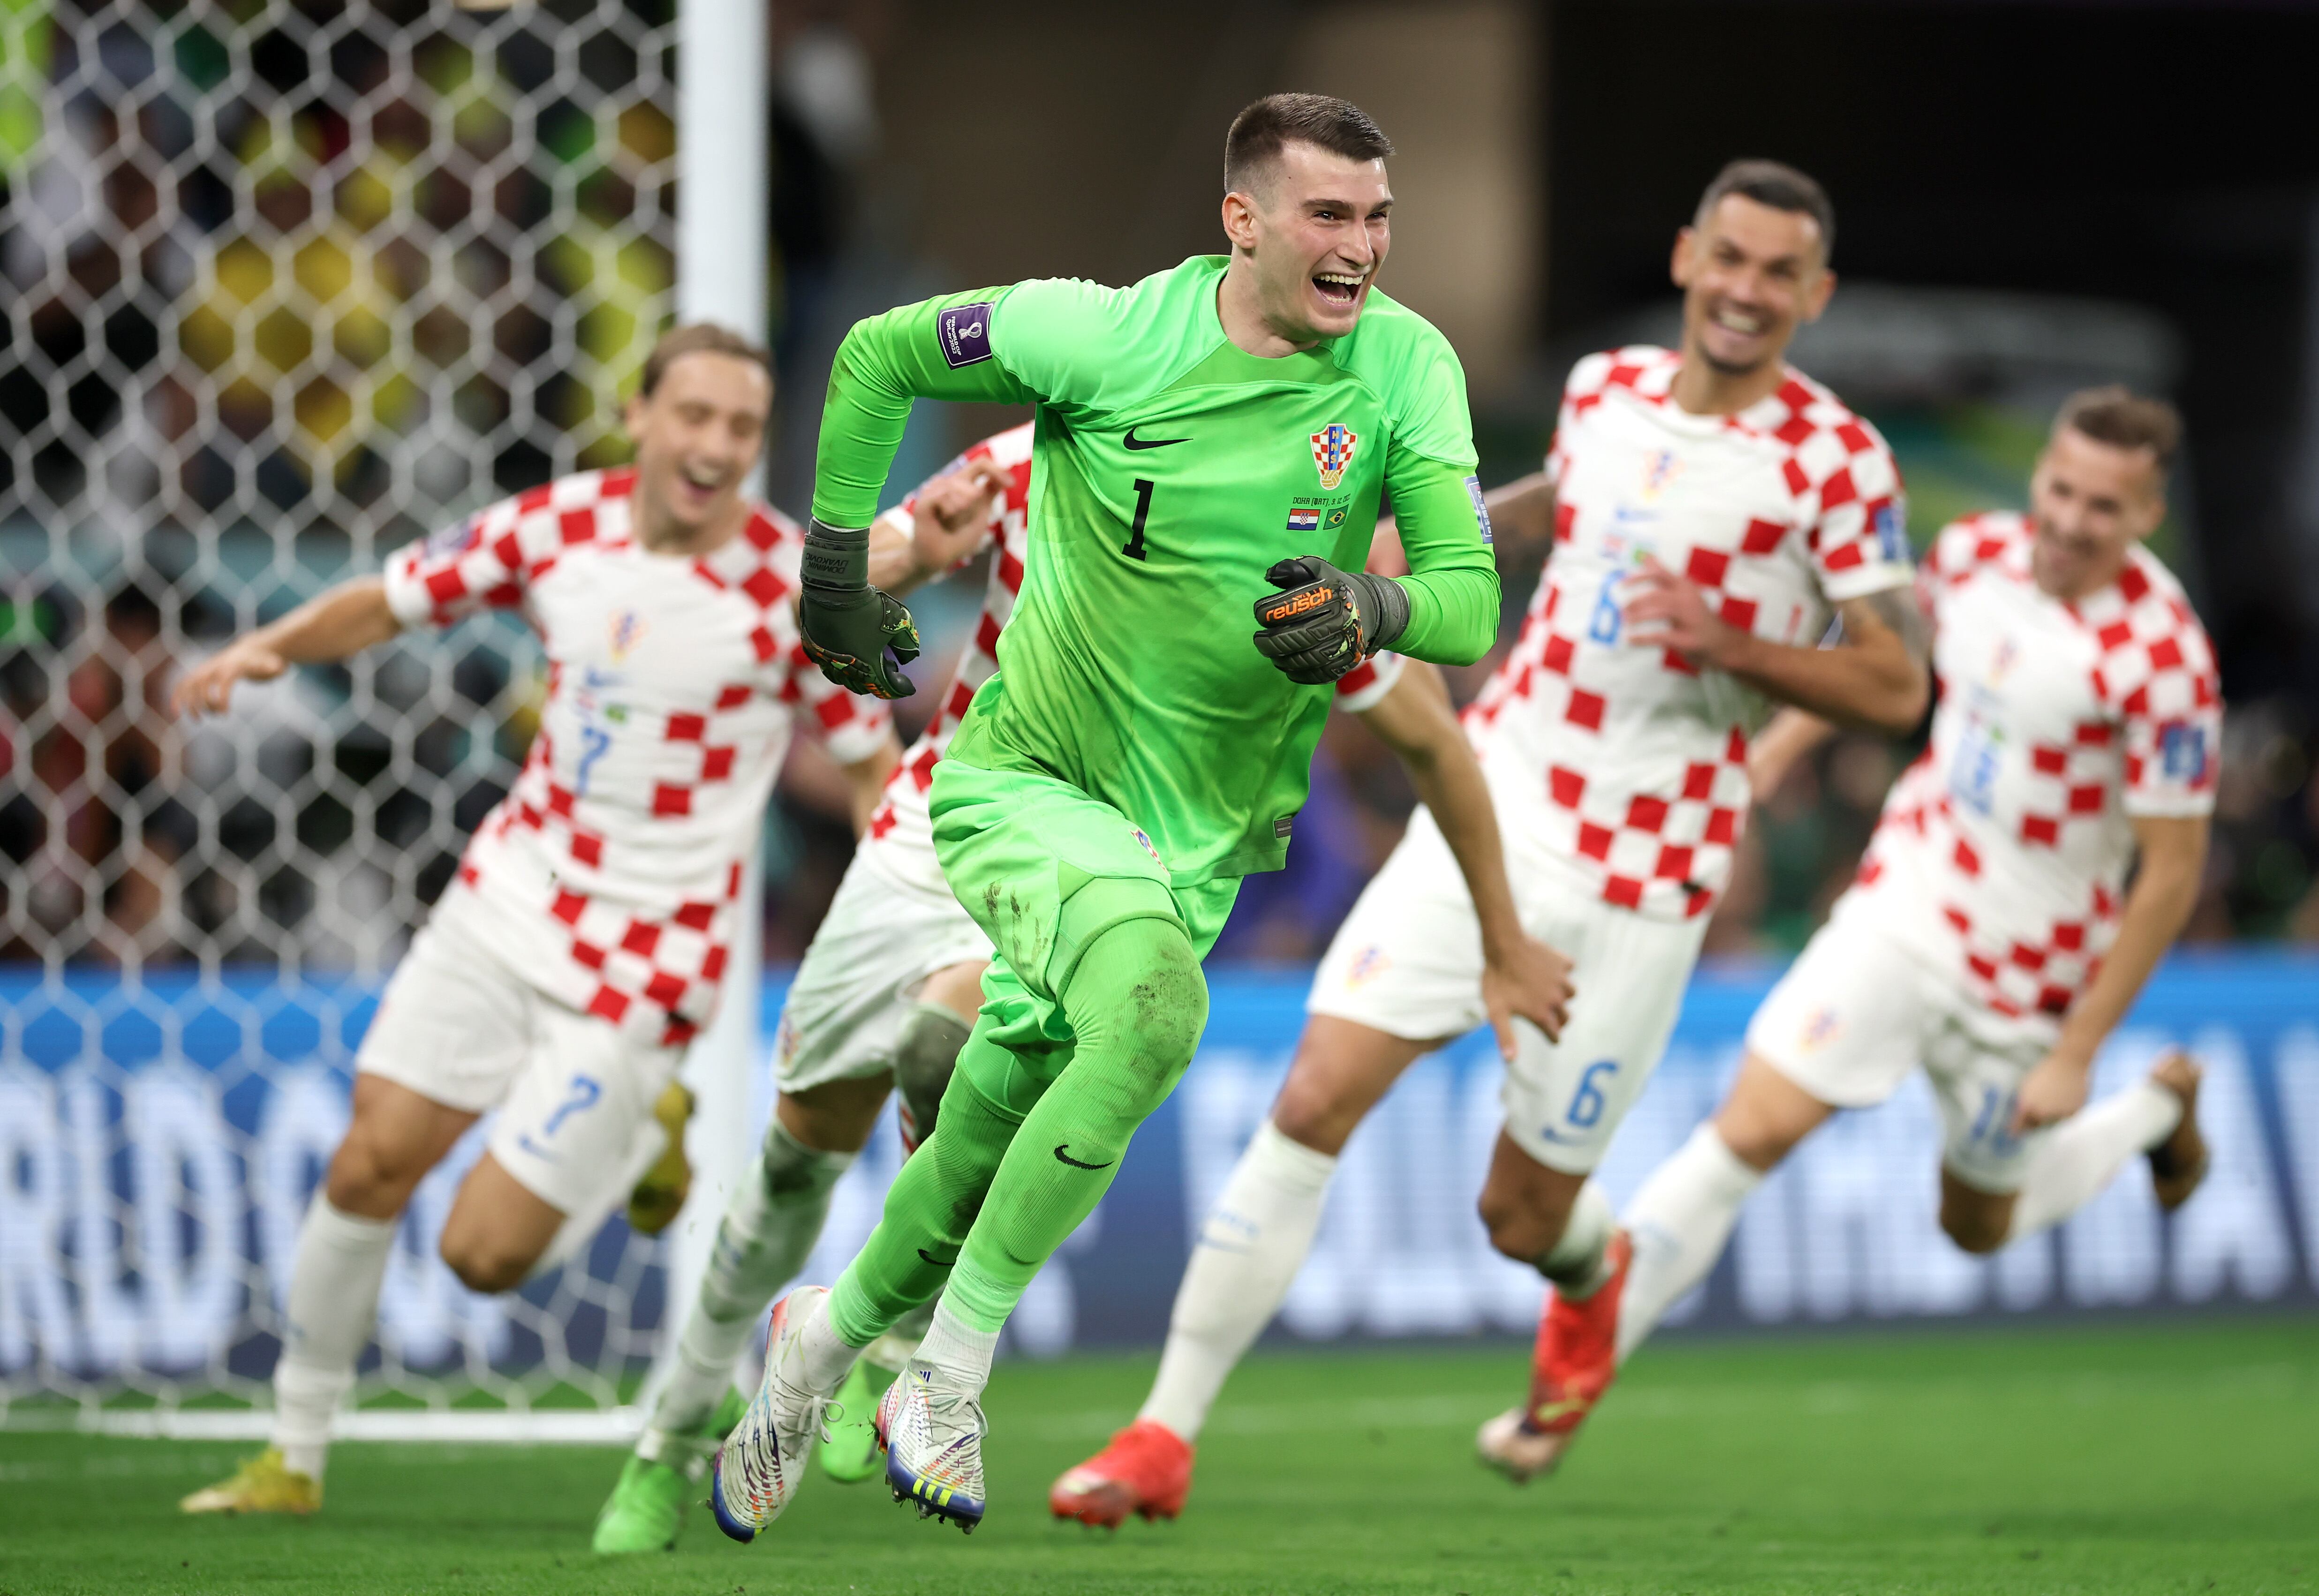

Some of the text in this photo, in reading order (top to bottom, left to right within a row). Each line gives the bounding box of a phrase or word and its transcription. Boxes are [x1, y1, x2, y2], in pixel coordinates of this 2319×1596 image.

[1122, 478, 1155, 561] 1
[1266, 586, 1332, 622] reusch
[577, 725, 612, 796] 7
[544, 1073, 601, 1135] 7
[1567, 1059, 1618, 1127] 6
